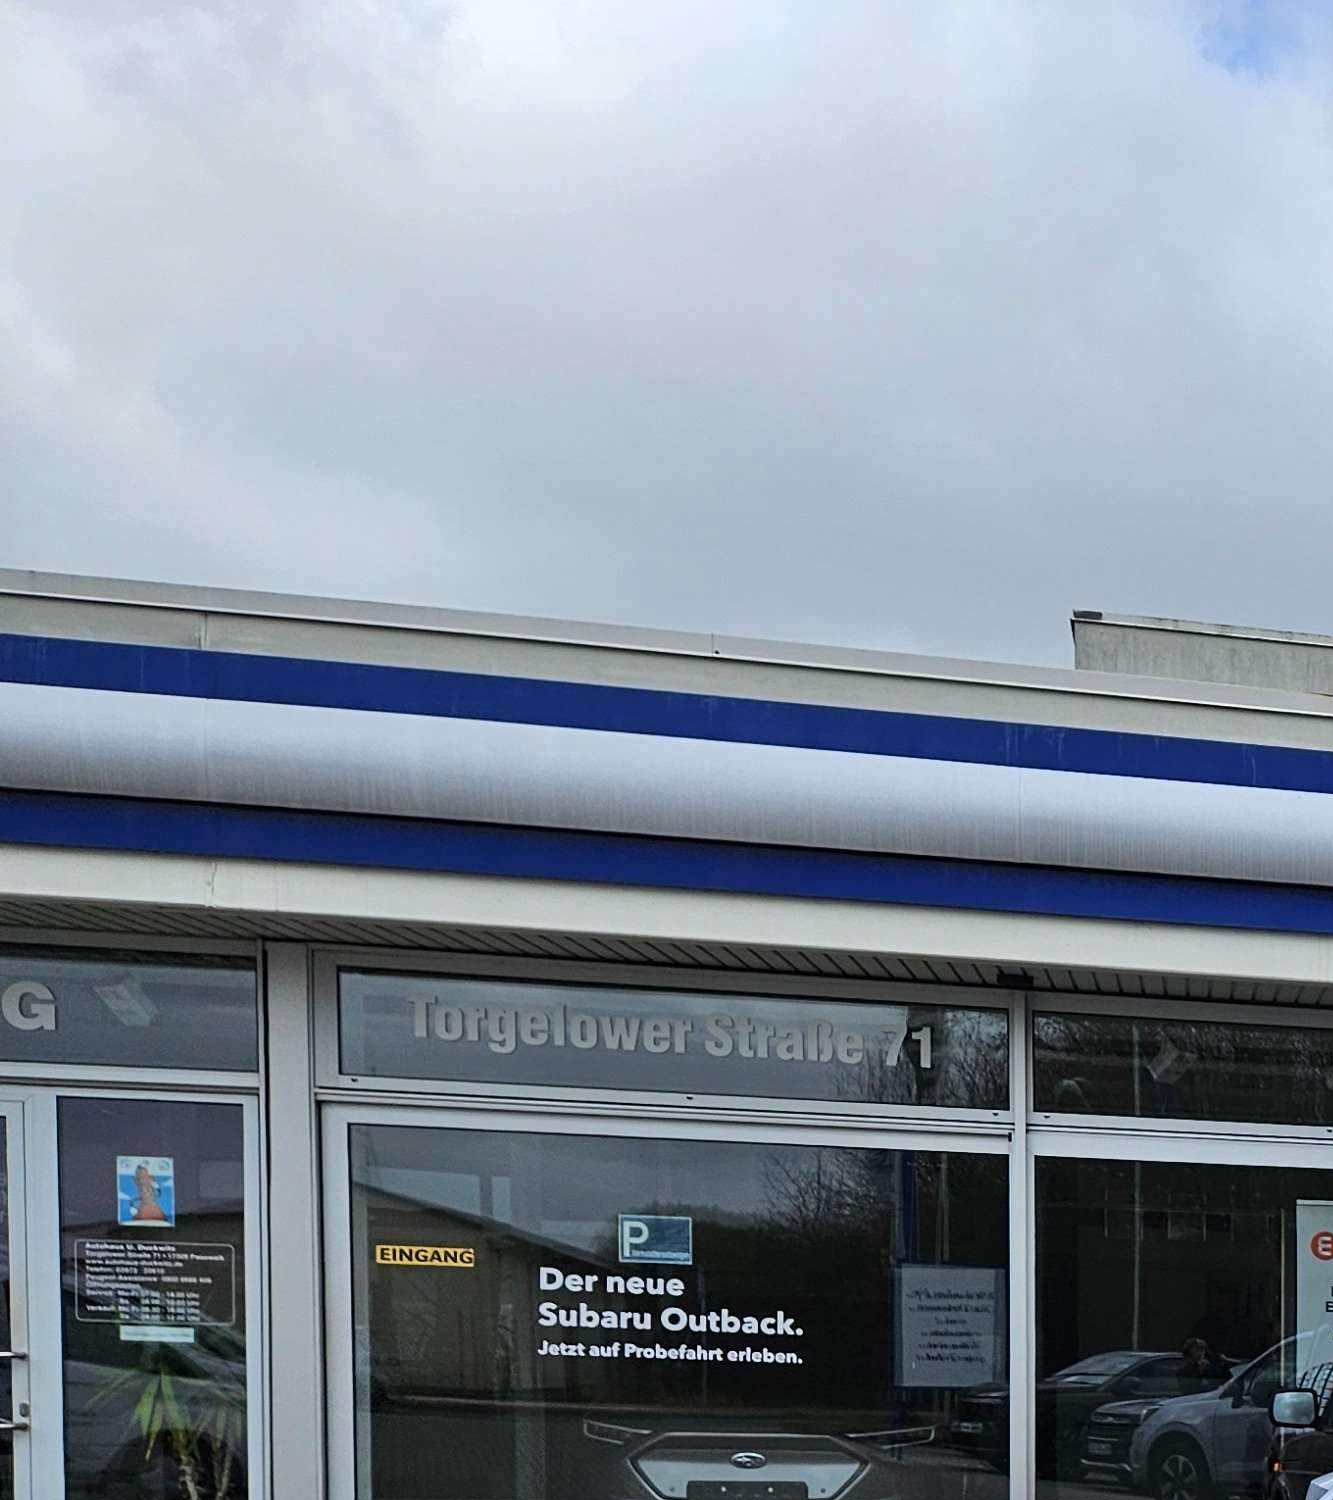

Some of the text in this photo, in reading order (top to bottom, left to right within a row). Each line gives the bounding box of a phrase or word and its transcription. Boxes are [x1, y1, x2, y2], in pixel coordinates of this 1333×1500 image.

[410, 999, 933, 1069] Torgelower Straße 71
[380, 1247, 473, 1264] EINGANG
[539, 1267, 685, 1296] Der neue
[538, 1301, 804, 1336] Subaru Outback.
[537, 1340, 803, 1365] Jetzt auf Probefahrt erleben.
